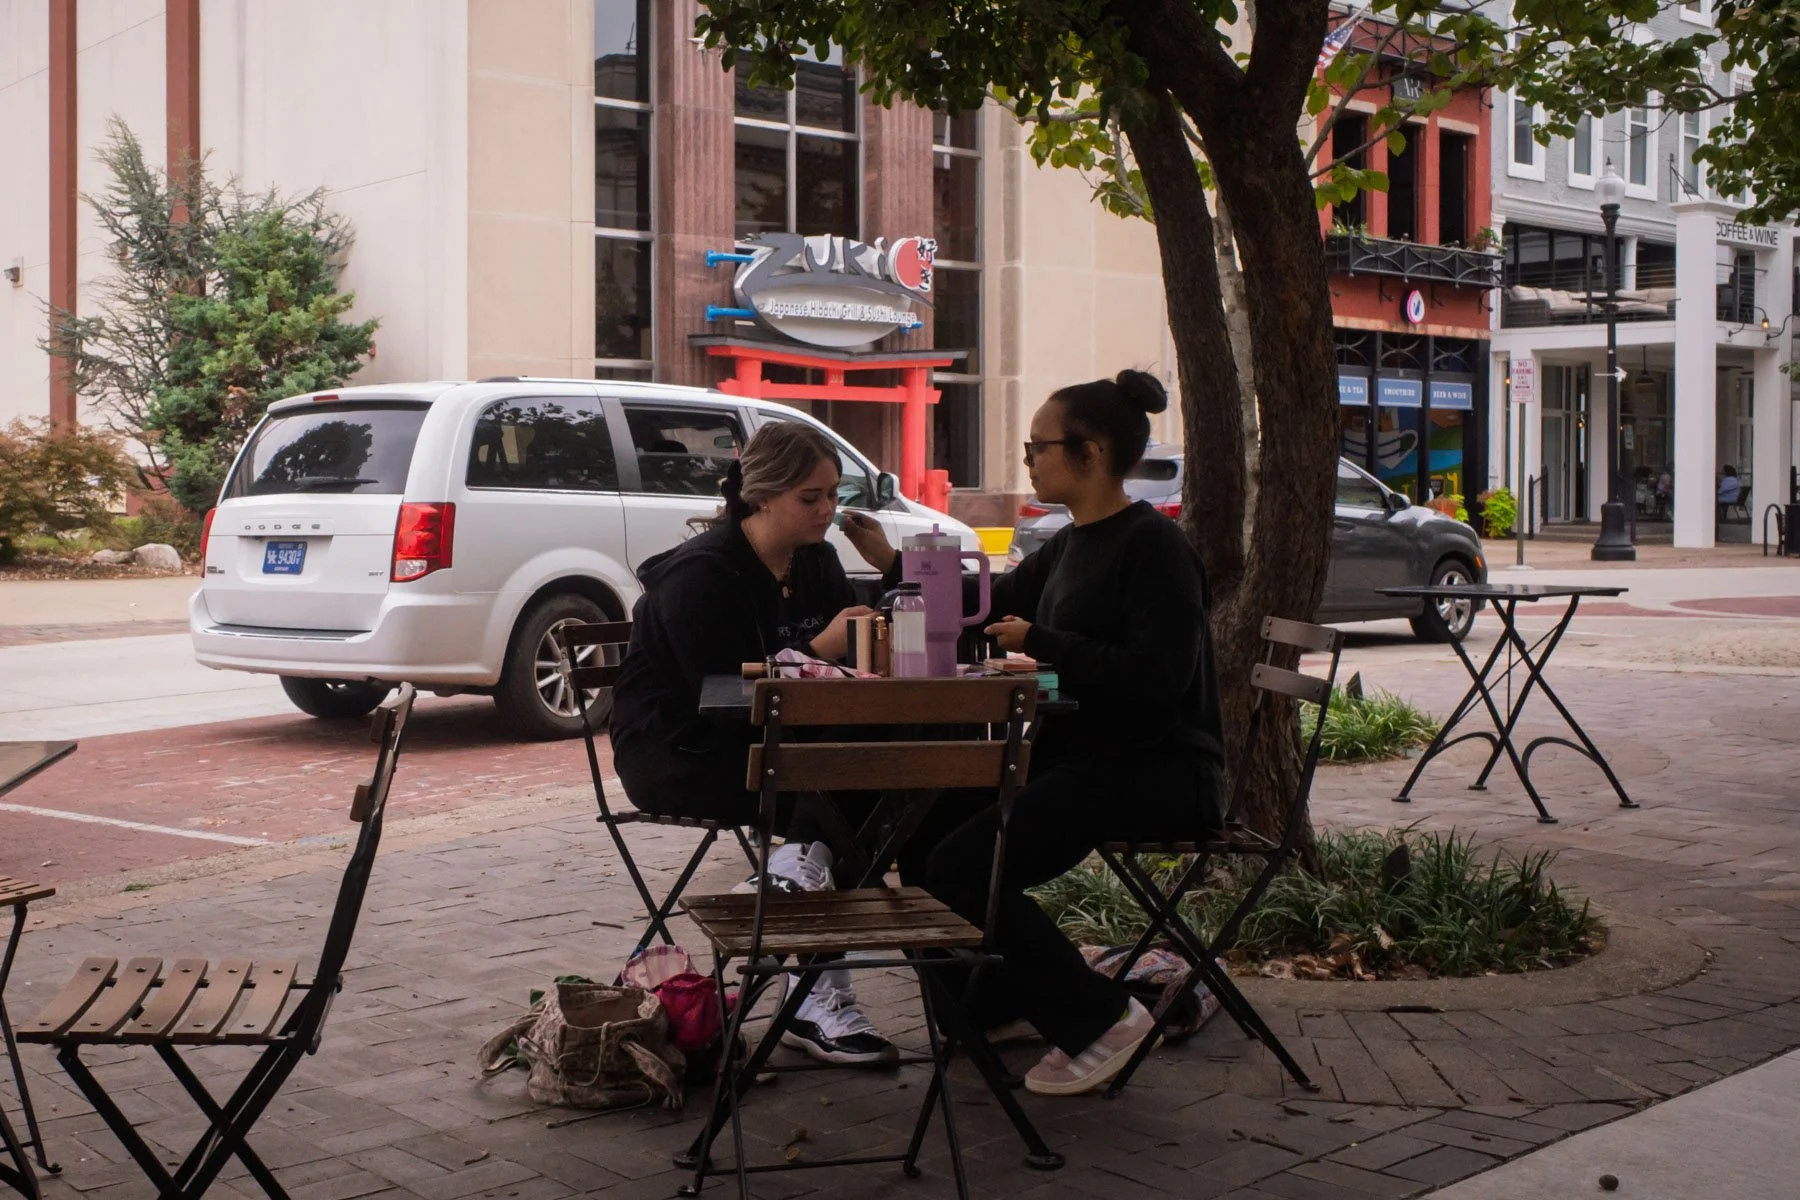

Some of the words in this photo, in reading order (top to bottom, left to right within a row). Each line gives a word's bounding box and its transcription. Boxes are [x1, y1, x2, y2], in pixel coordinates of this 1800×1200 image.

[1754, 228, 1778, 245] WINE
[769, 298, 808, 318] Japanese
[809, 300, 840, 318] Hibachi
[841, 303, 859, 319] Grill
[860, 305, 866, 320] &
[867, 305, 889, 322] Sushi
[889, 310, 917, 327] Lounge
